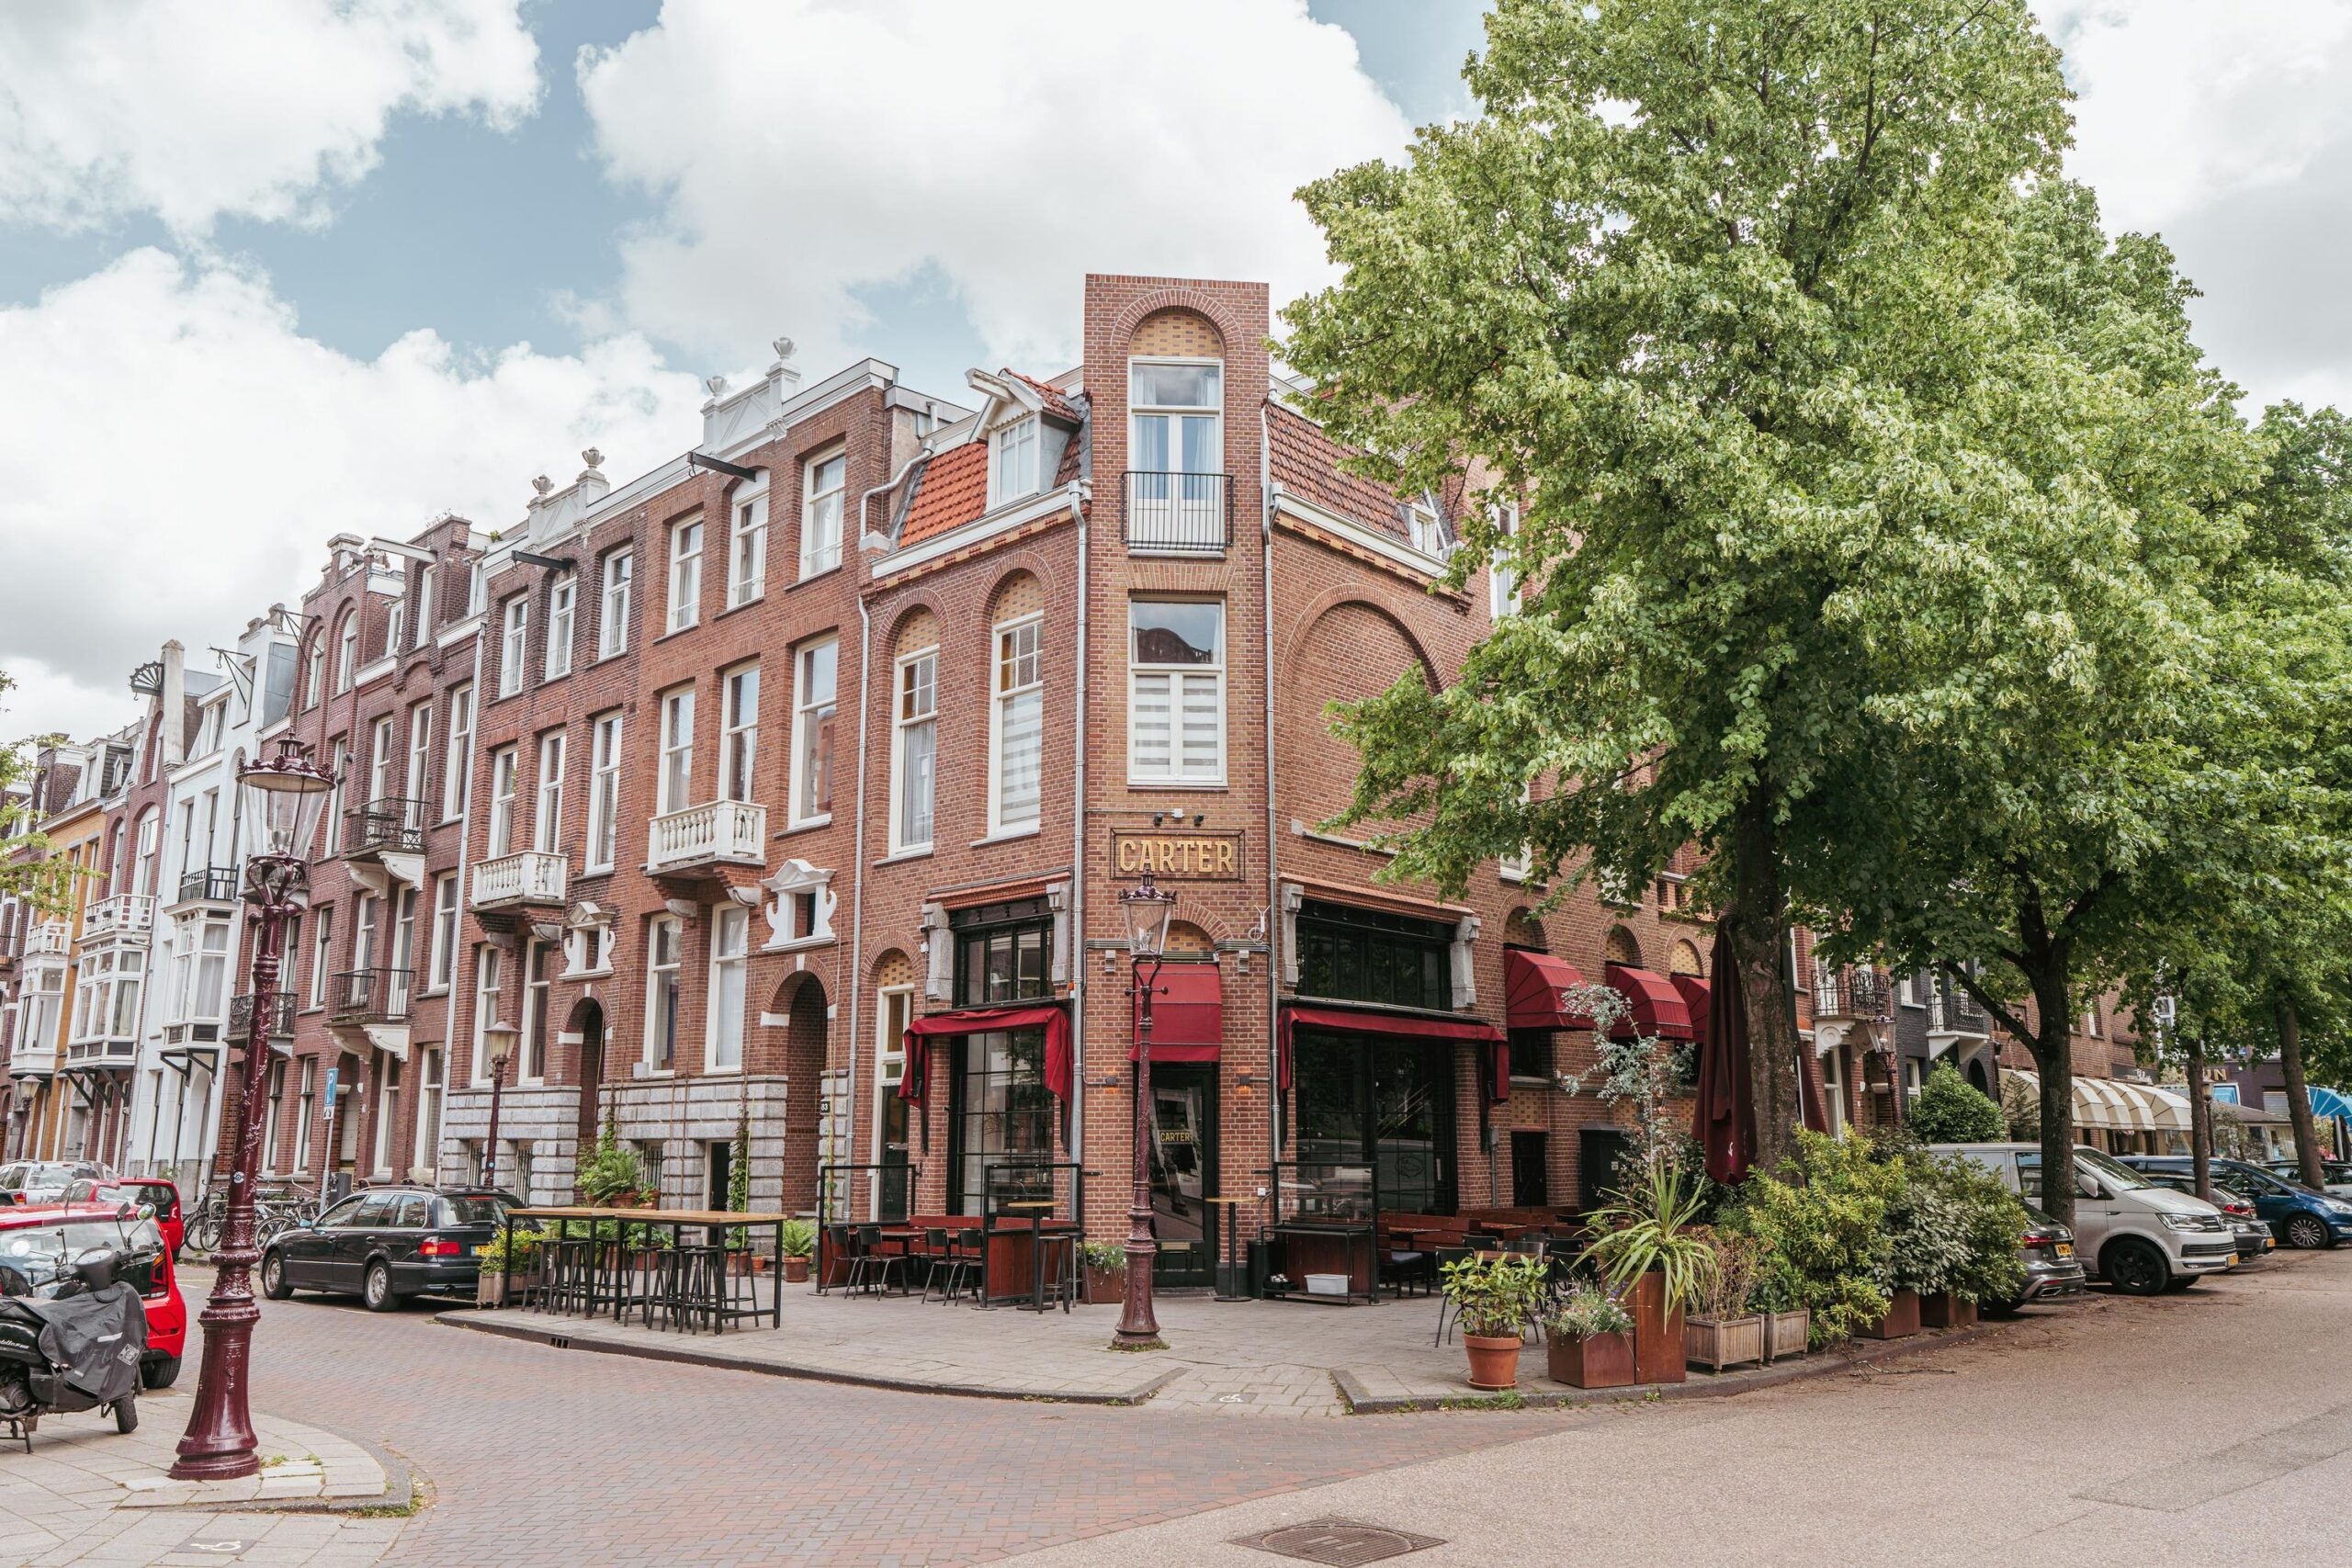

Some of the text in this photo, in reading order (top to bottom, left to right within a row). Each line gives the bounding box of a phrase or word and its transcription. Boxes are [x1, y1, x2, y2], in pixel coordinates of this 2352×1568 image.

[1119, 839, 1235, 873] CARTER
[328, 1072, 334, 1090] P
[1159, 1132, 1191, 1142] CARTER
